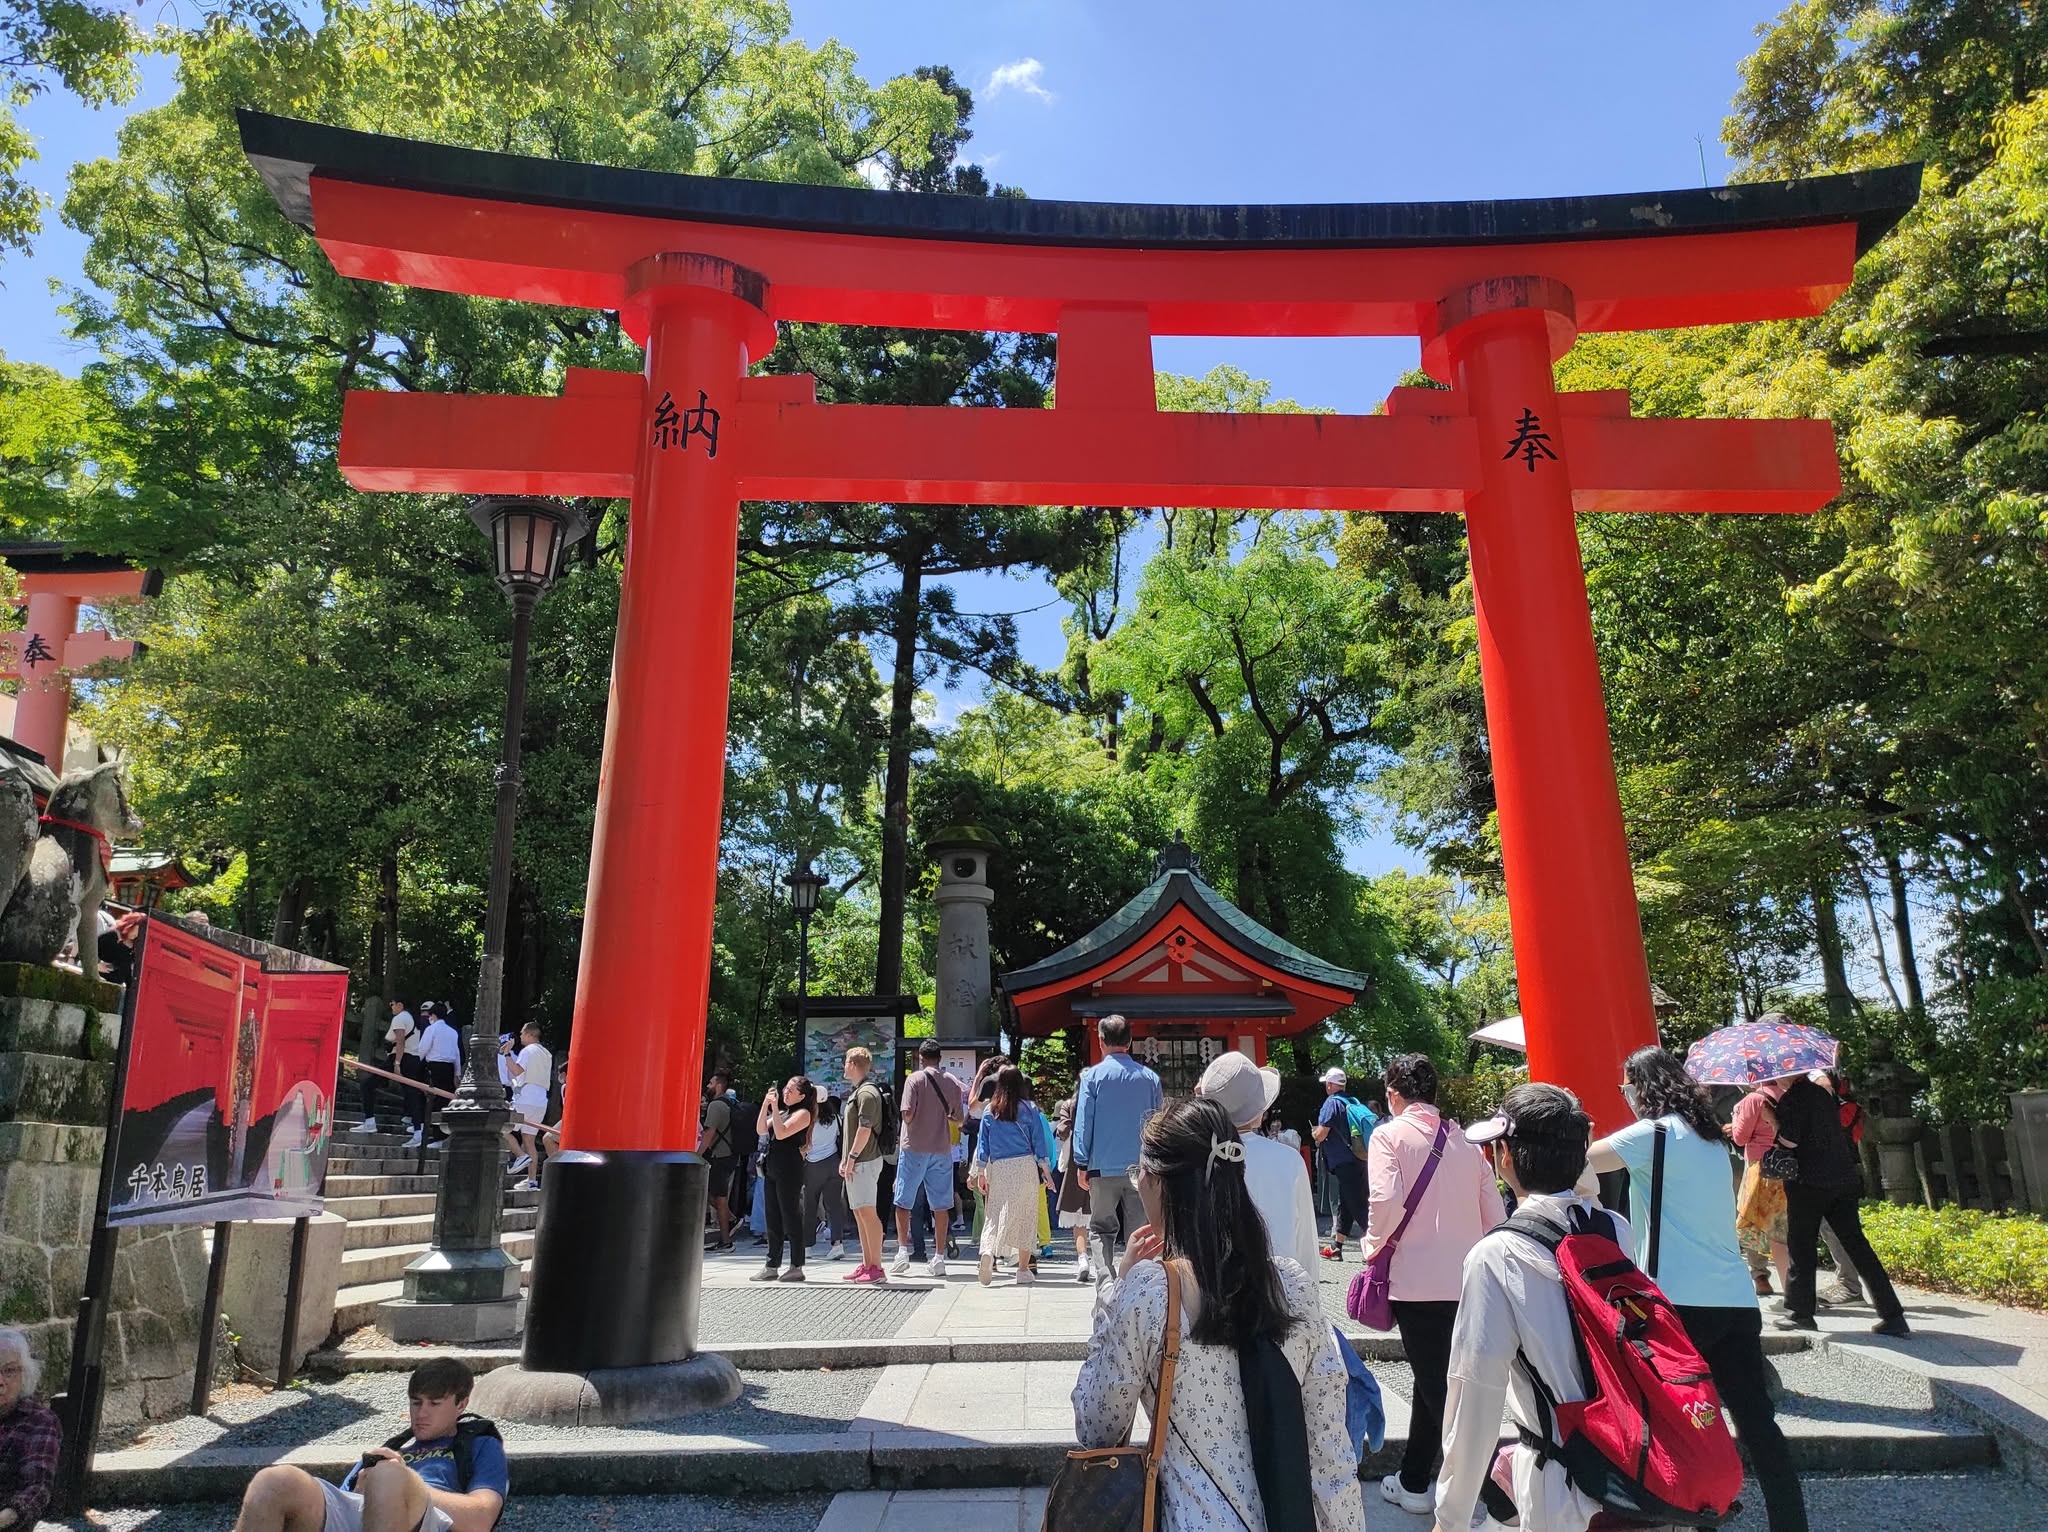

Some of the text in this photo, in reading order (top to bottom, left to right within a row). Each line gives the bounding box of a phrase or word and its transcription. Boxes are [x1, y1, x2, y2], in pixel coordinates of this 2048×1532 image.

[653, 389, 721, 458] 納
[1501, 407, 1559, 473] 奉
[23, 633, 57, 669] 奉
[128, 1163, 206, 1202] 千本鳥居
